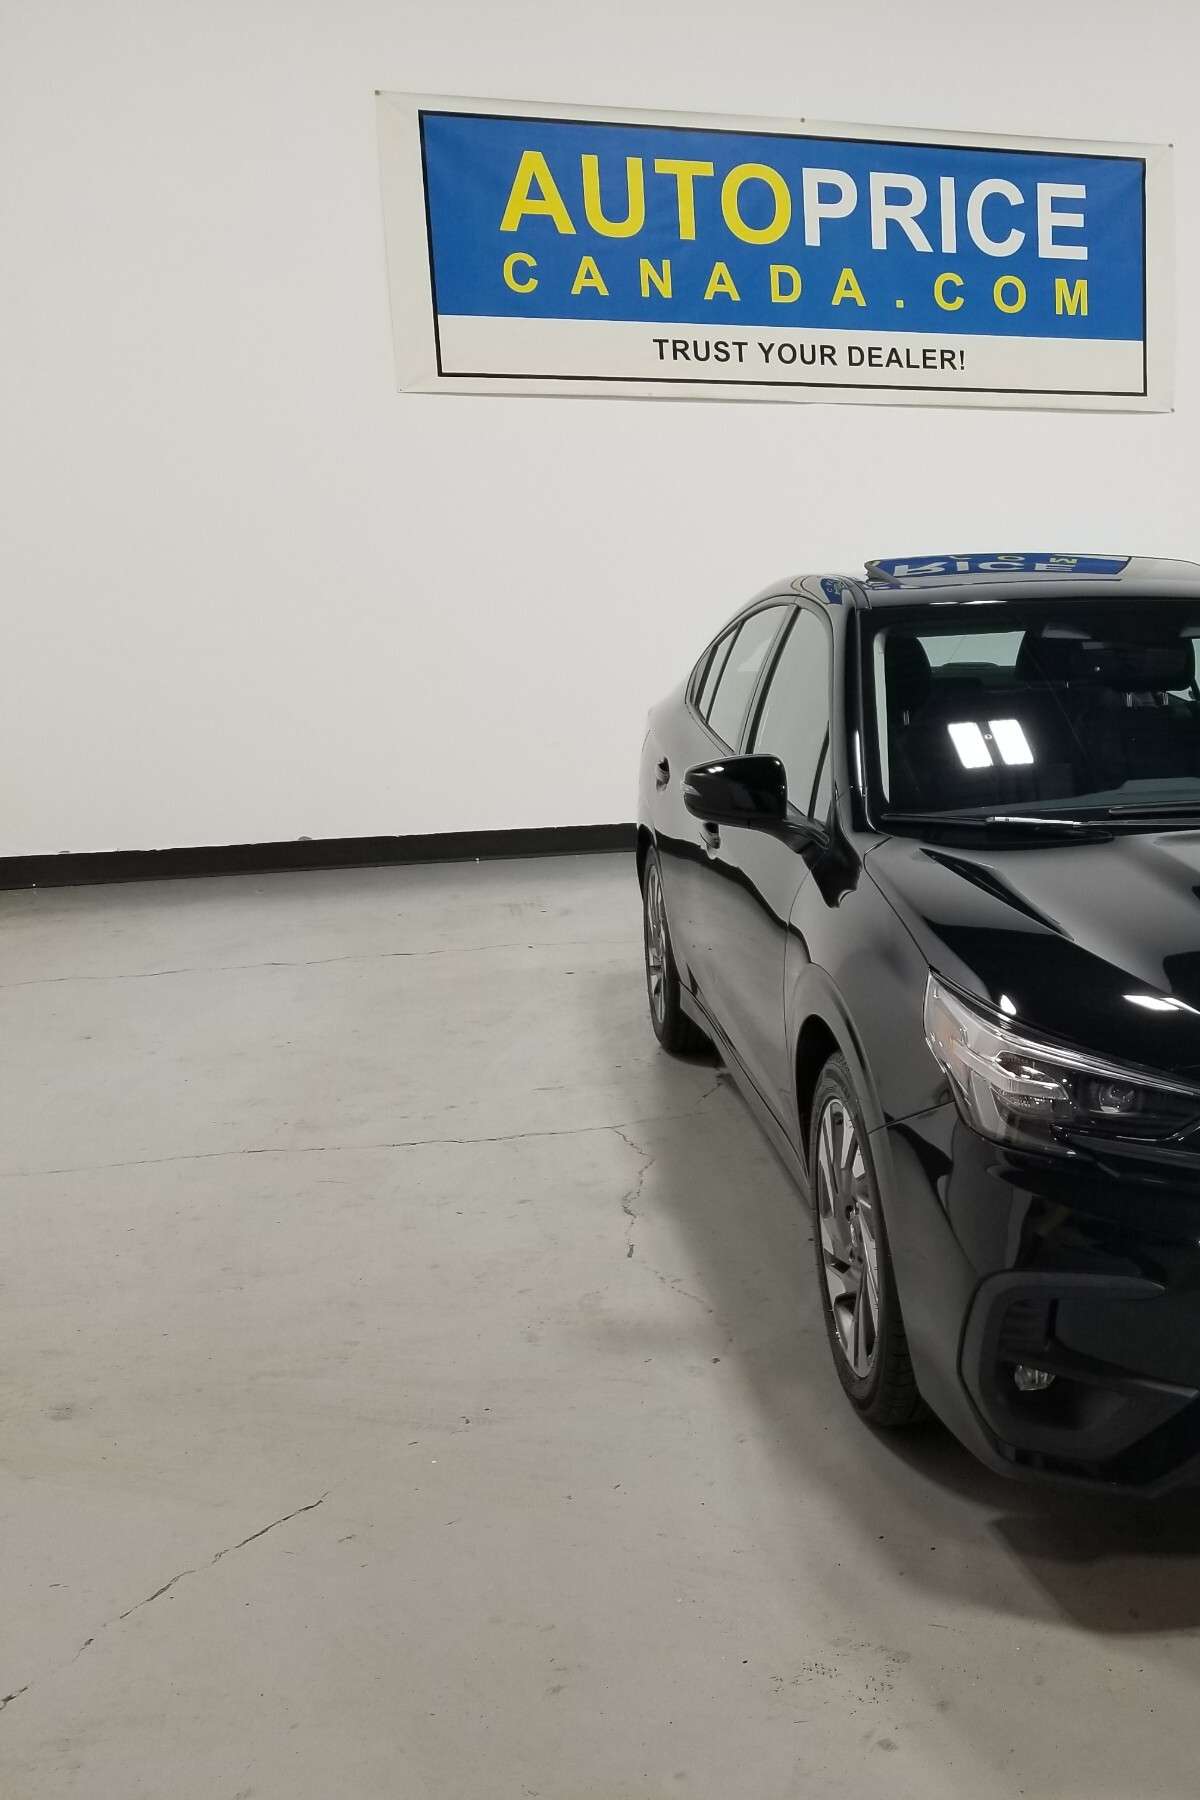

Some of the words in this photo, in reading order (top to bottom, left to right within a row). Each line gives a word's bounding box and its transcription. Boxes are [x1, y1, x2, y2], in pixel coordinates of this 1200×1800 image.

[499, 151, 1088, 261] AUTOPRICE
[503, 252, 1088, 316] CANADA.COM
[652, 338, 749, 363] TRUST
[757, 342, 838, 366] YOUR
[847, 346, 966, 371] DEALER!
